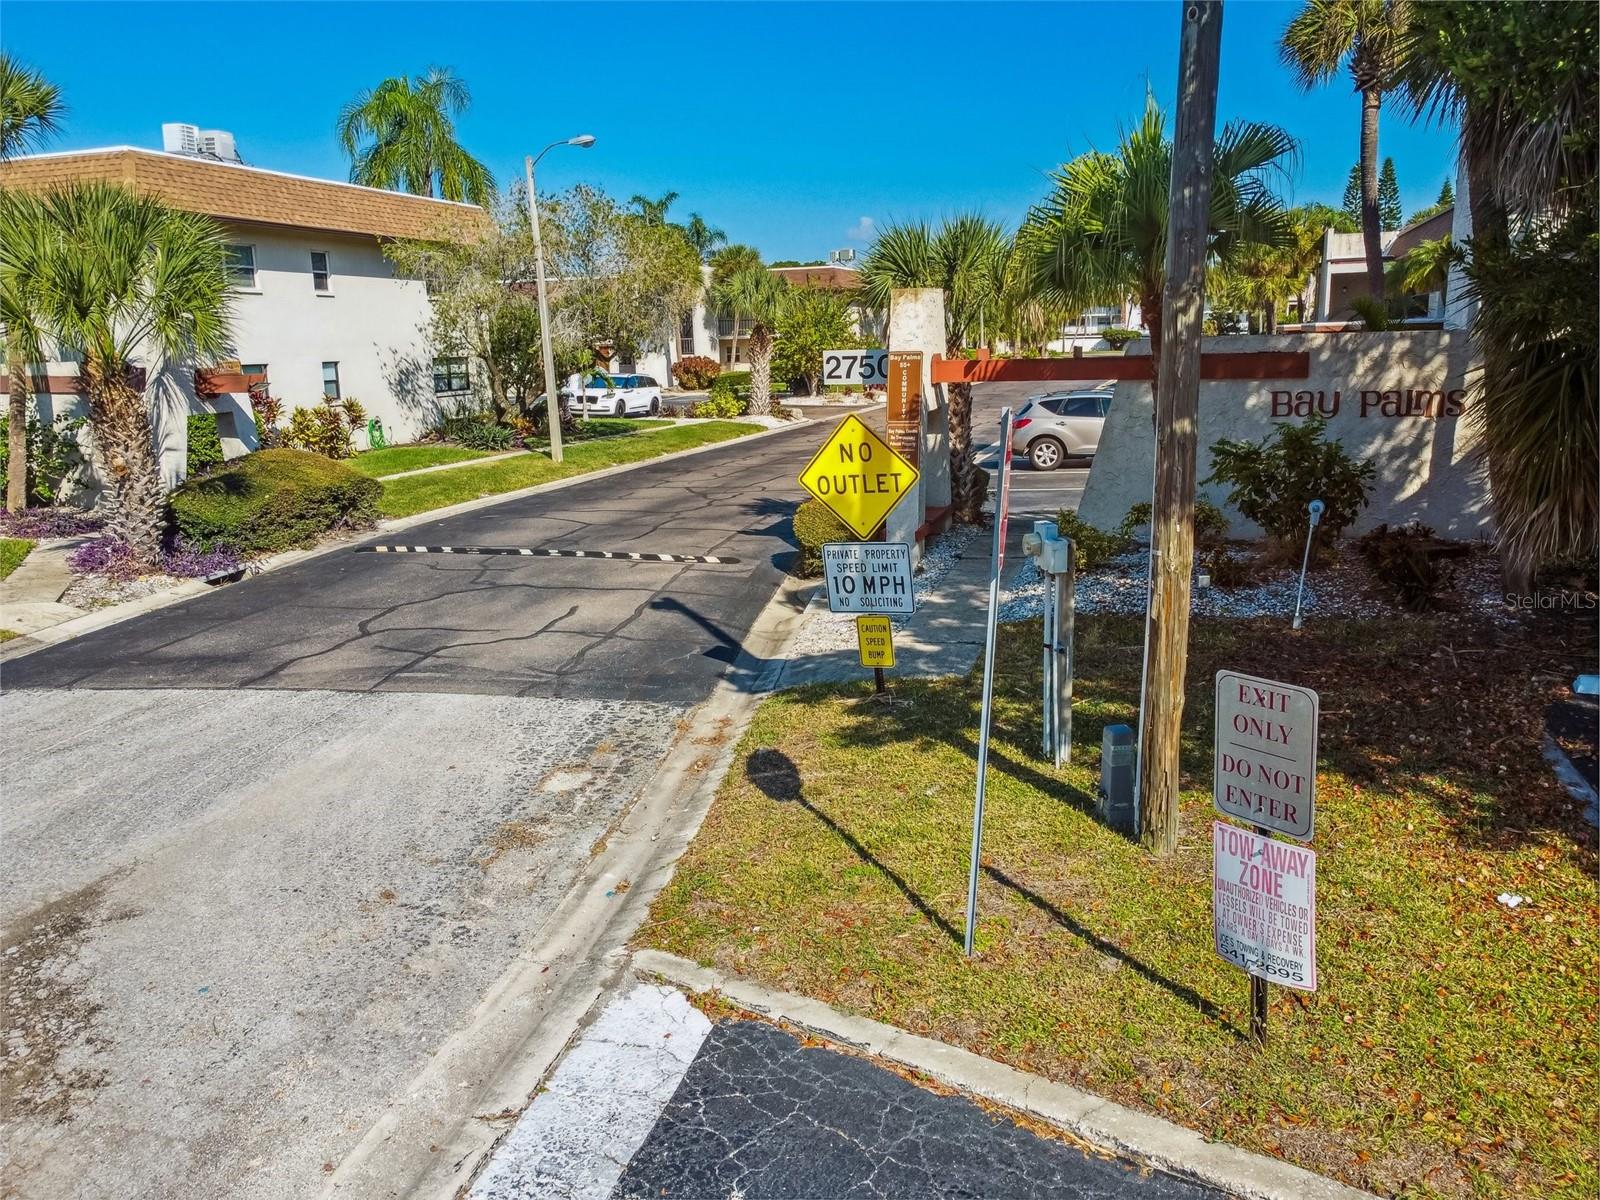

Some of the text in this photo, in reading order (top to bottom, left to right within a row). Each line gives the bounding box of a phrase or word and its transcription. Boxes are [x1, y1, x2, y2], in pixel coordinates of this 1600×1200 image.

[889, 354, 902, 362] Bay
[839, 442, 873, 463] NO
[817, 472, 902, 495] OUTLET
[826, 549, 906, 560] PRIVATE PROPERTY
[836, 562, 898, 573] SPEED LIMIT
[833, 575, 906, 595] 10 MPH
[839, 596, 904, 607] NO SOLICITING
[861, 624, 887, 633] CAUTION
[865, 637, 886, 646] SPEED
[868, 650, 886, 659] BUMP
[1238, 684, 1291, 713] EXIT
[1232, 713, 1294, 745] ONLY
[1221, 753, 1306, 794] DO NOT
[1225, 784, 1299, 825] ENTER
[1218, 826, 1309, 879] TOW AWAY
[1239, 860, 1284, 899] ZONE
[1217, 877, 1309, 922] UNAUTHORIZED VEHICLES OR
[1217, 891, 1309, 936] VESSELS WILL BE TOWED
[1222, 907, 1303, 948] AT OWNER'S EXPENSE
[1236, 939, 1259, 957] TOWING
[1267, 952, 1304, 971] RECOVERY
[1265, 937, 1283, 952] DAYS
